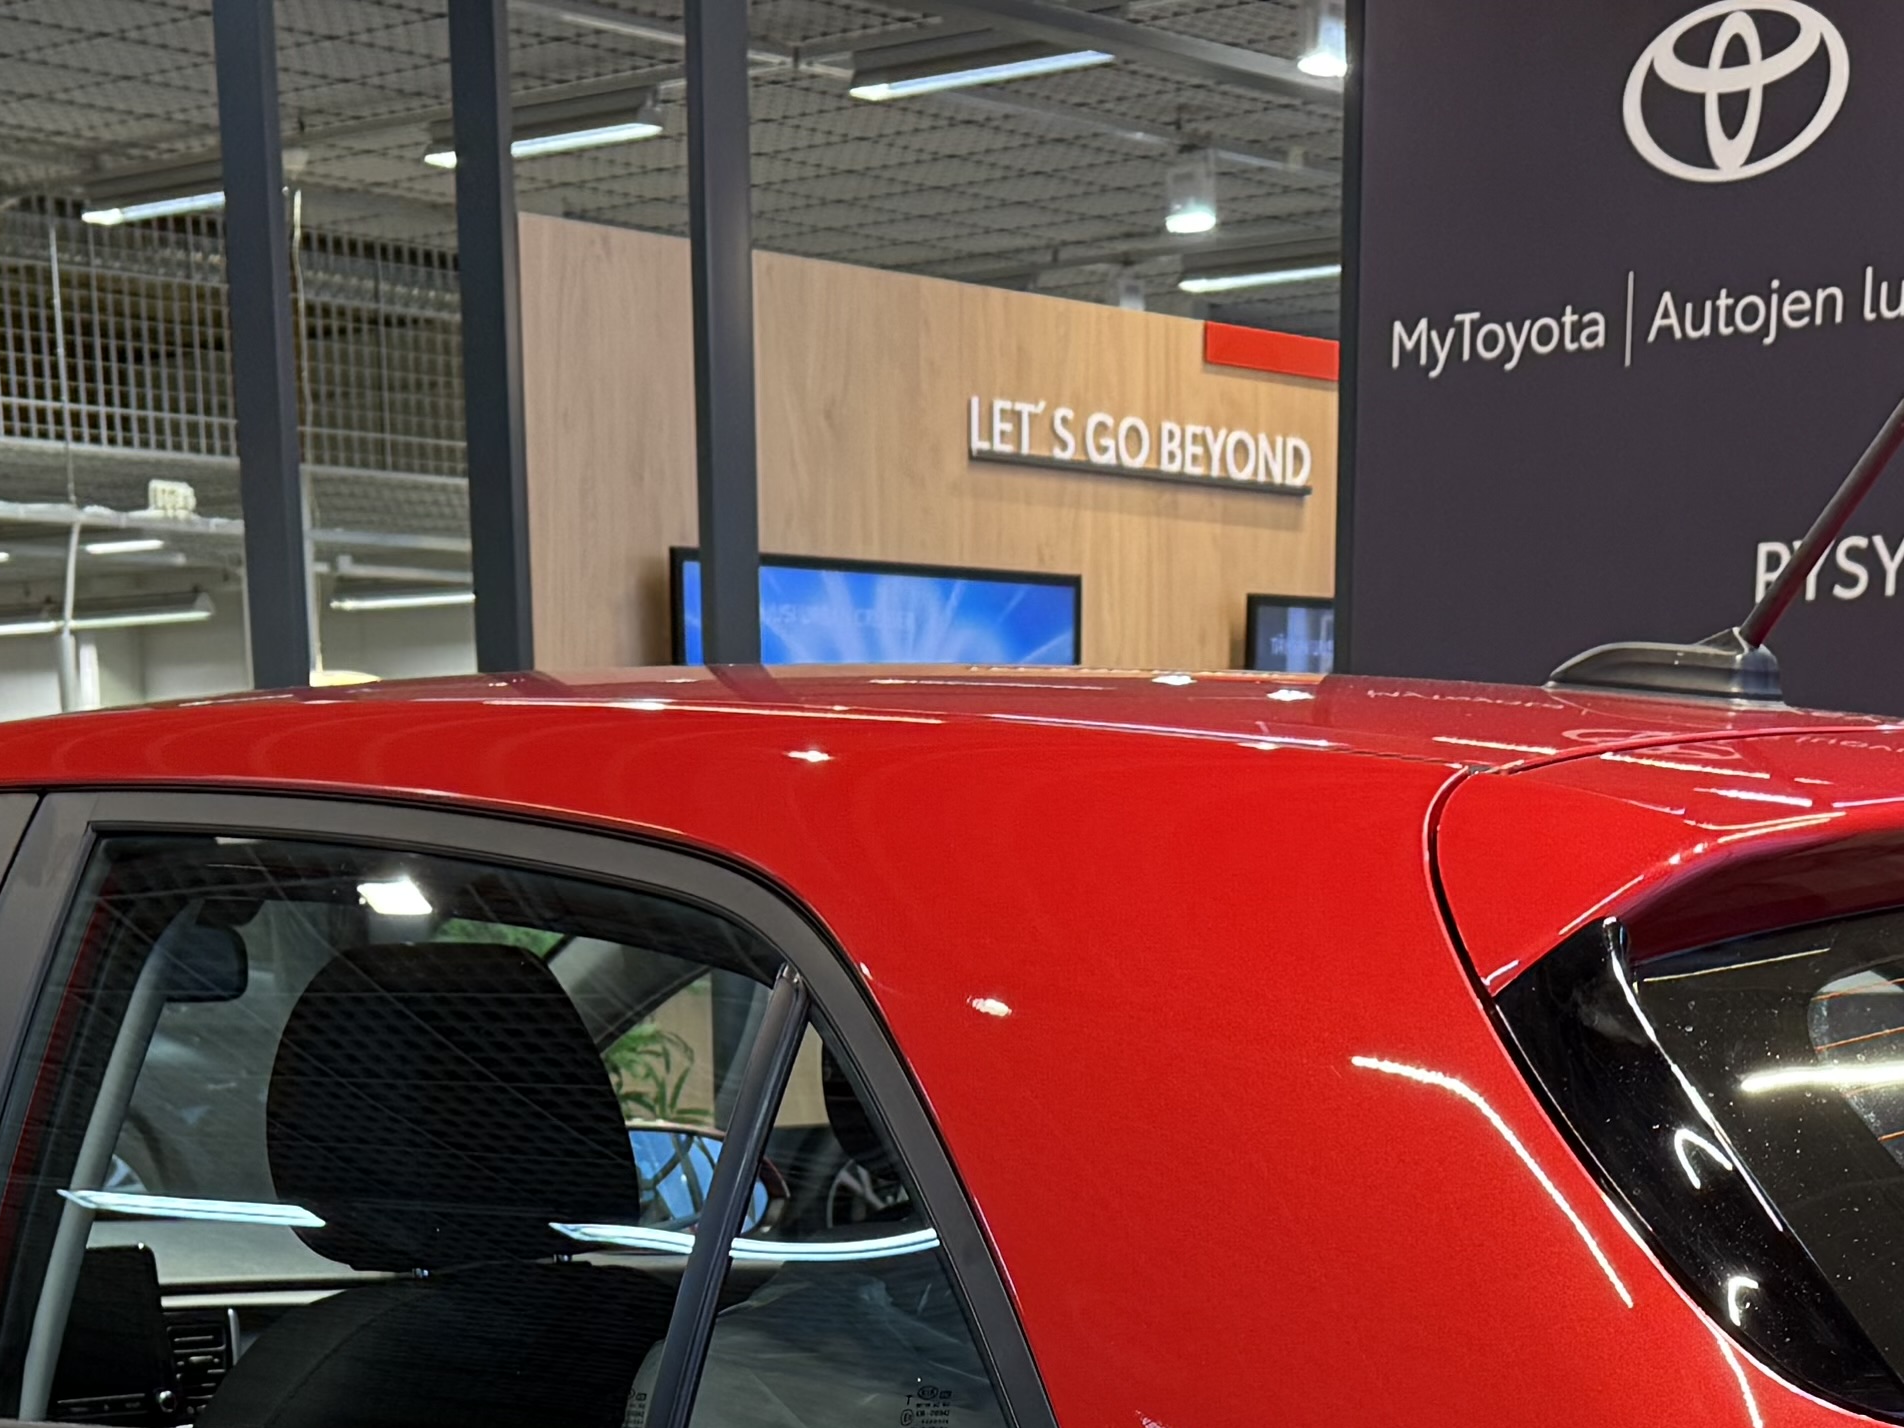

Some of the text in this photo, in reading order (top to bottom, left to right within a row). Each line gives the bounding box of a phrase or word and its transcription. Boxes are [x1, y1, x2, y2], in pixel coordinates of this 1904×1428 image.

[1391, 303, 1607, 378] MyToyota
[1647, 279, 1844, 345] Autojen
[1086, 413, 1150, 468] GO
[1159, 421, 1312, 486] BEYOND
